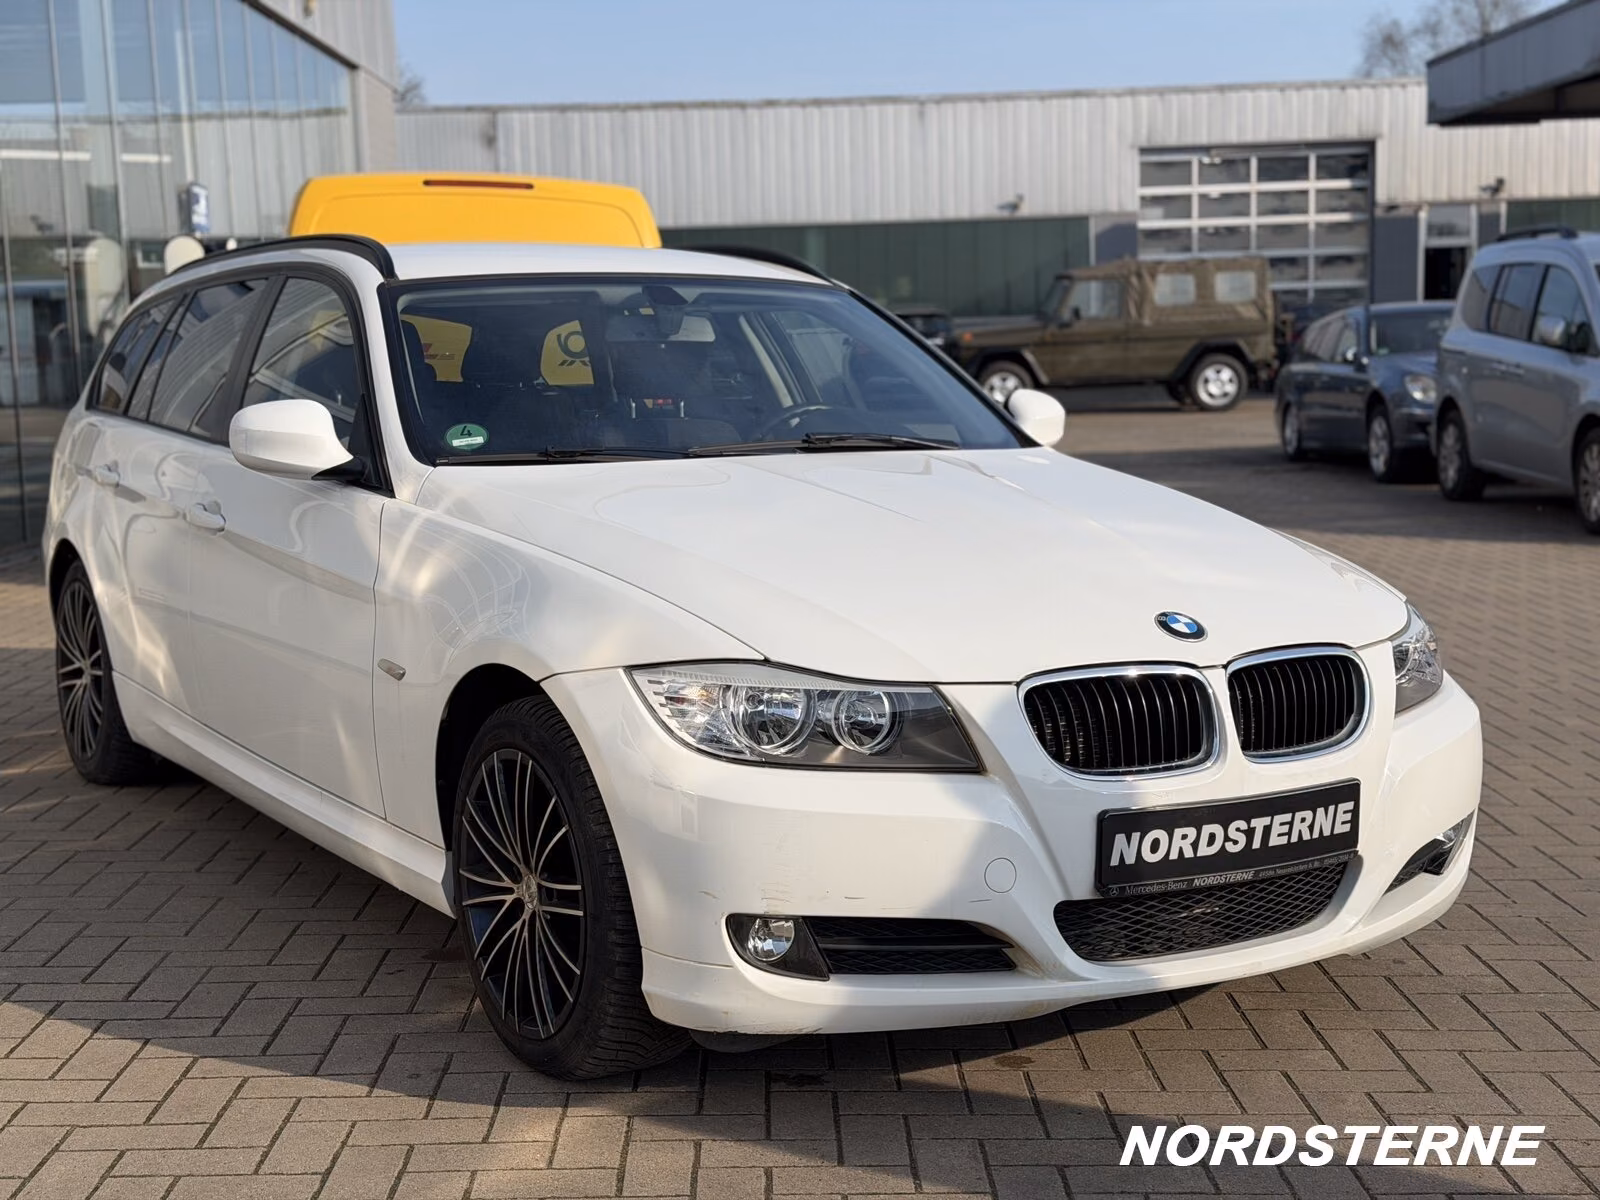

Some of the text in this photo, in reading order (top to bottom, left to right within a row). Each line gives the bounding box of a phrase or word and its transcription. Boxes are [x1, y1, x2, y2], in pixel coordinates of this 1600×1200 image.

[460, 425, 473, 437] 4
[1110, 801, 1354, 866] NORDSTERNE
[1124, 870, 1255, 896] Mercedes-Benz NORDSTERNE
